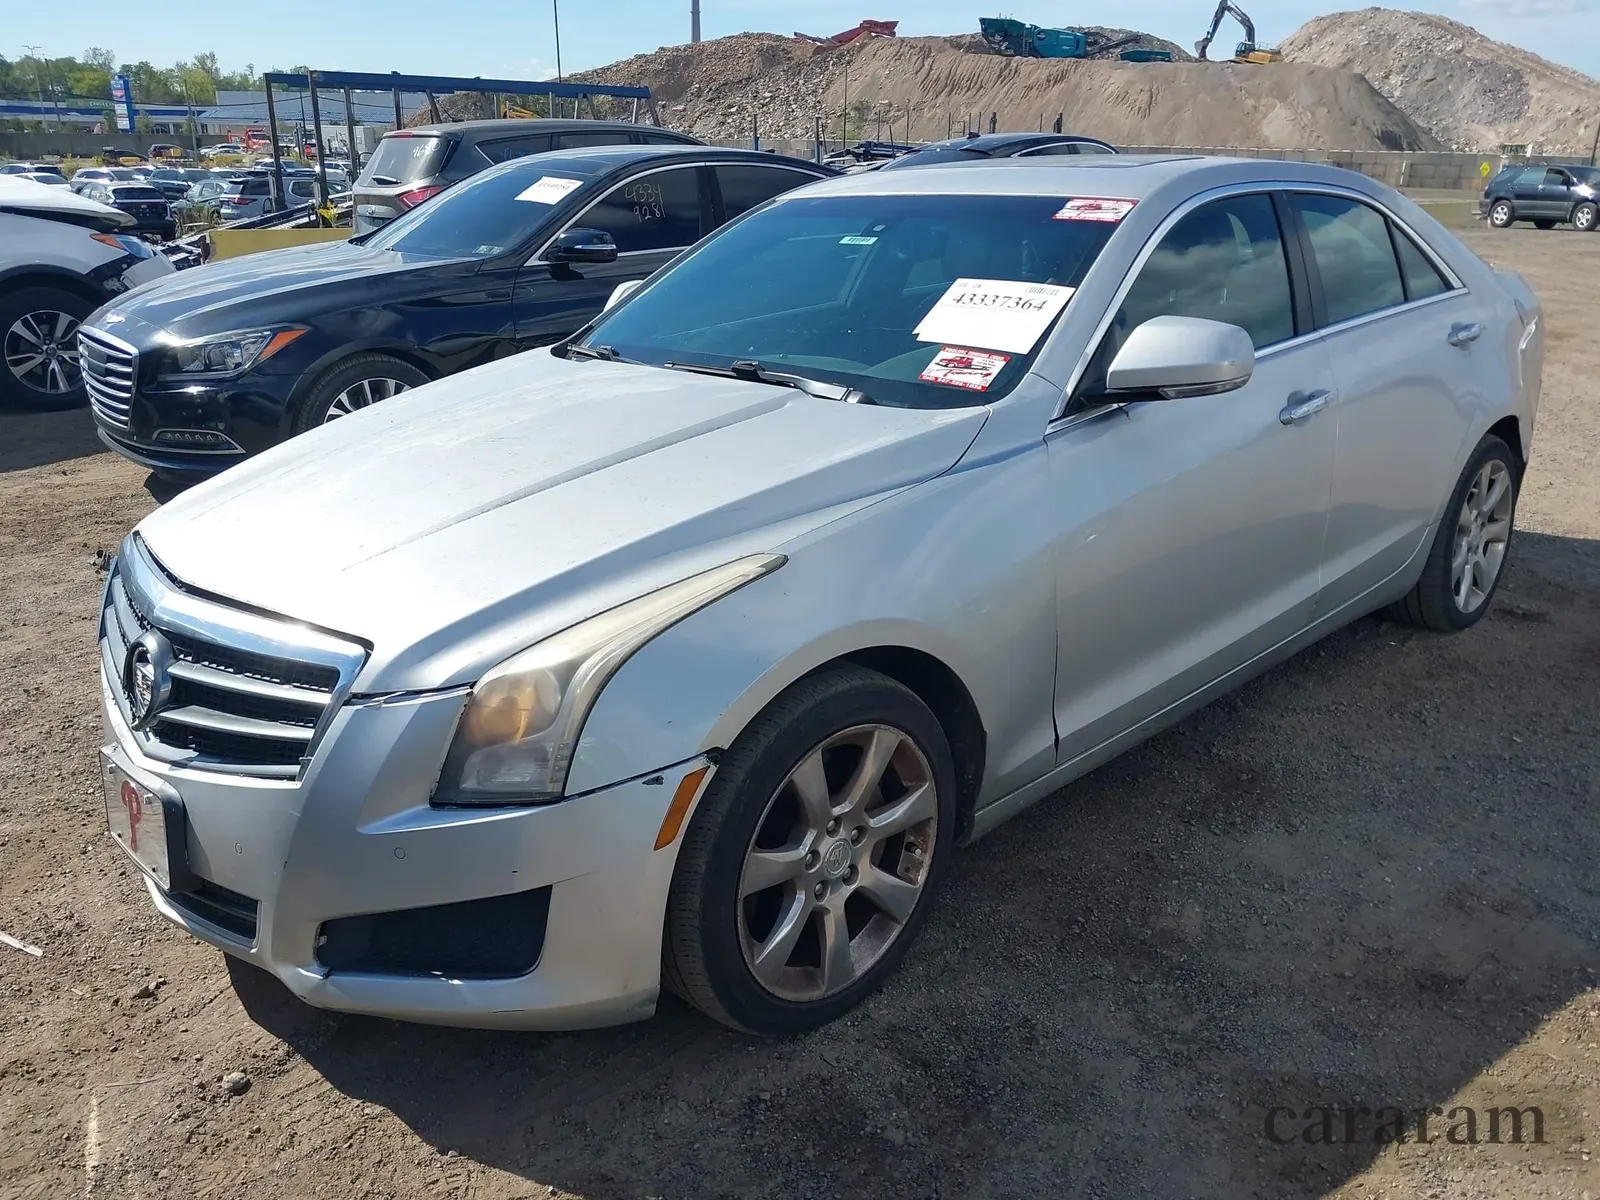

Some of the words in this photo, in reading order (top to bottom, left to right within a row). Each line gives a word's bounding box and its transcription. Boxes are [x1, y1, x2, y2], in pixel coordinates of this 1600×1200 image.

[625, 183, 663, 204] 4334
[633, 201, 666, 222] 9281
[952, 292, 1048, 311] 43337364
